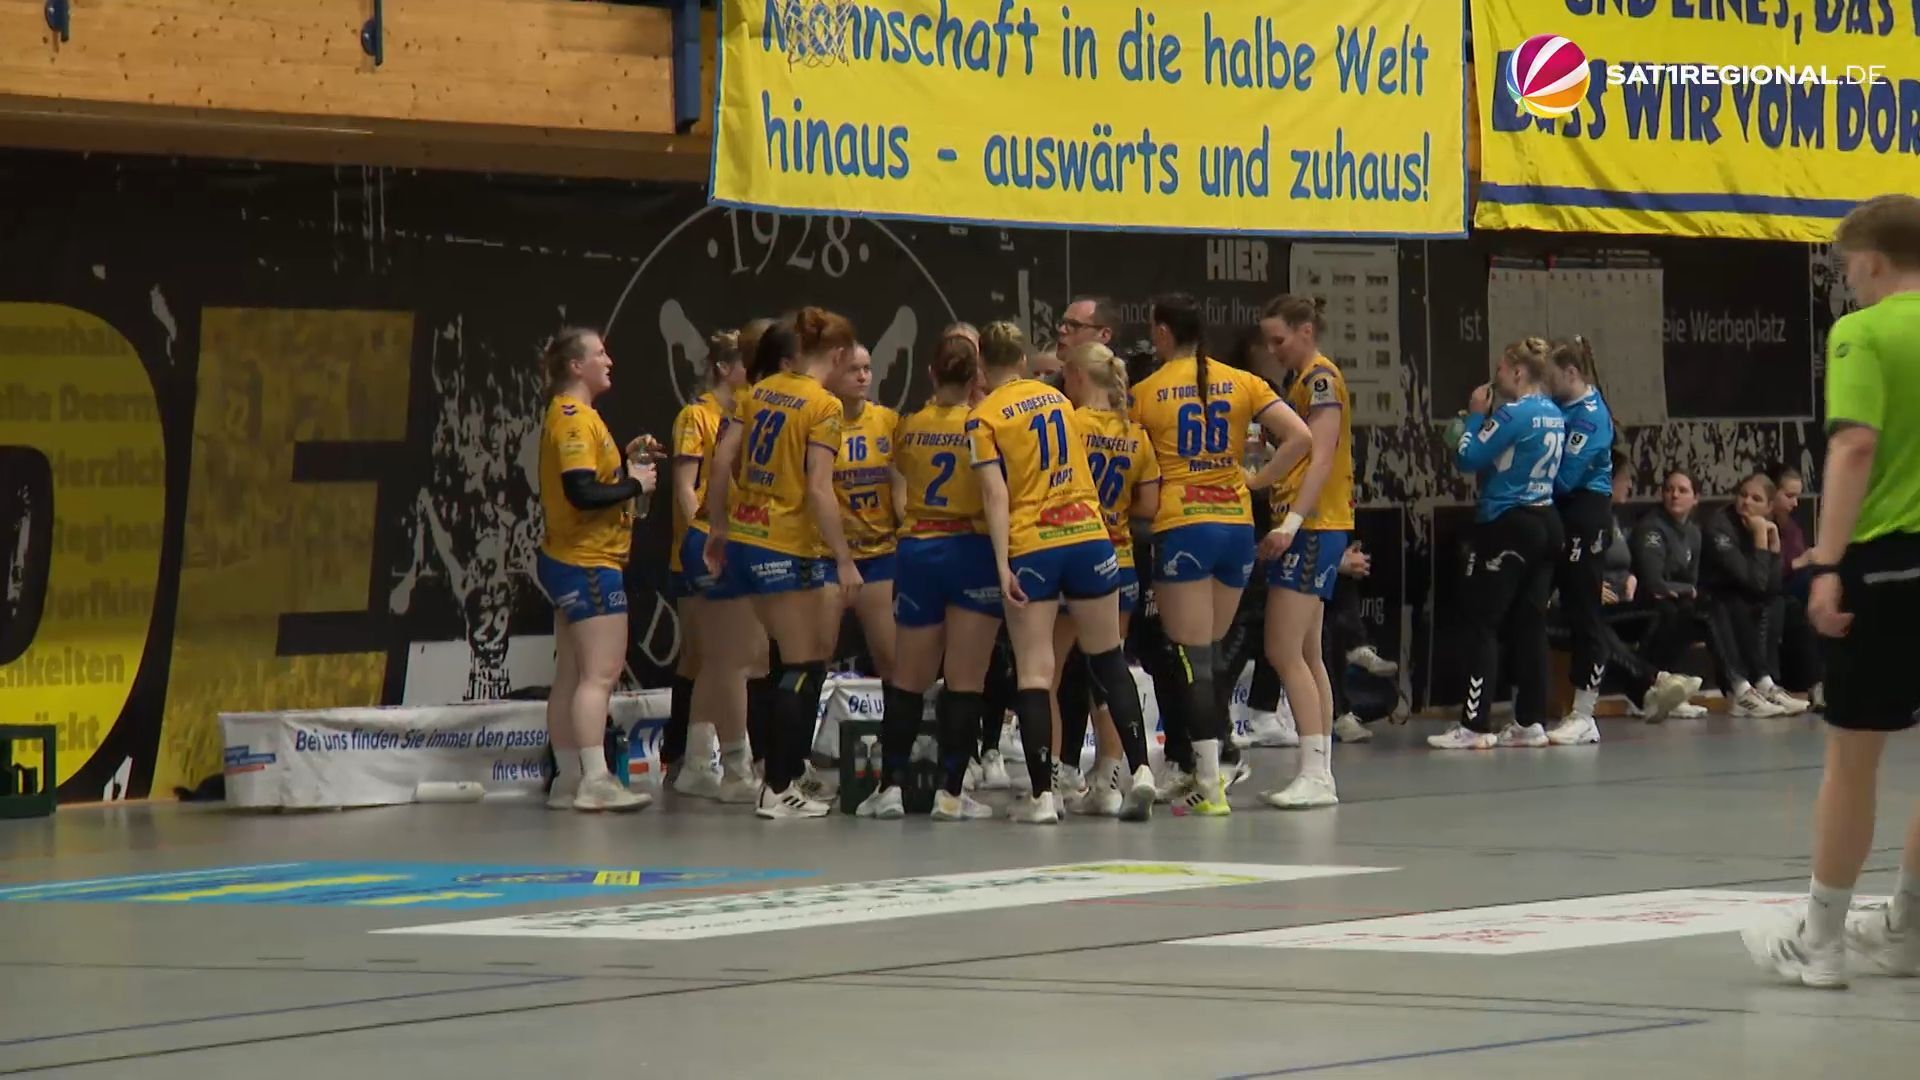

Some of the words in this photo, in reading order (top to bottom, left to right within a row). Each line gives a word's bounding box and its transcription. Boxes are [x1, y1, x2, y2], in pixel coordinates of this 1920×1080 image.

[762, 0, 1039, 78] Mannschaft
[1062, 6, 1097, 80] in
[1118, 7, 1182, 84] die
[1204, 12, 1316, 91] halbe
[1335, 24, 1429, 96] Welt
[761, 89, 910, 180] hinaus
[984, 123, 1179, 196] auswärts
[1200, 124, 1270, 198] und
[1289, 127, 1431, 203] zuhaus!
[727, 208, 852, 278] 1928
[1206, 238, 1270, 282] HIER
[1689, 305, 1787, 351] Werbeplatz
[748, 408, 786, 466] 13
[846, 435, 867, 463] 16
[1028, 408, 1068, 472] 11
[1177, 399, 1231, 458] 66
[924, 451, 956, 507] 2
[295, 728, 321, 752] Bei
[324, 733, 348, 751] uns
[351, 728, 399, 750] finden
[400, 730, 425, 749] Sie
[426, 728, 473, 748] immer
[475, 726, 504, 747] den
[492, 759, 518, 780] Ihre
